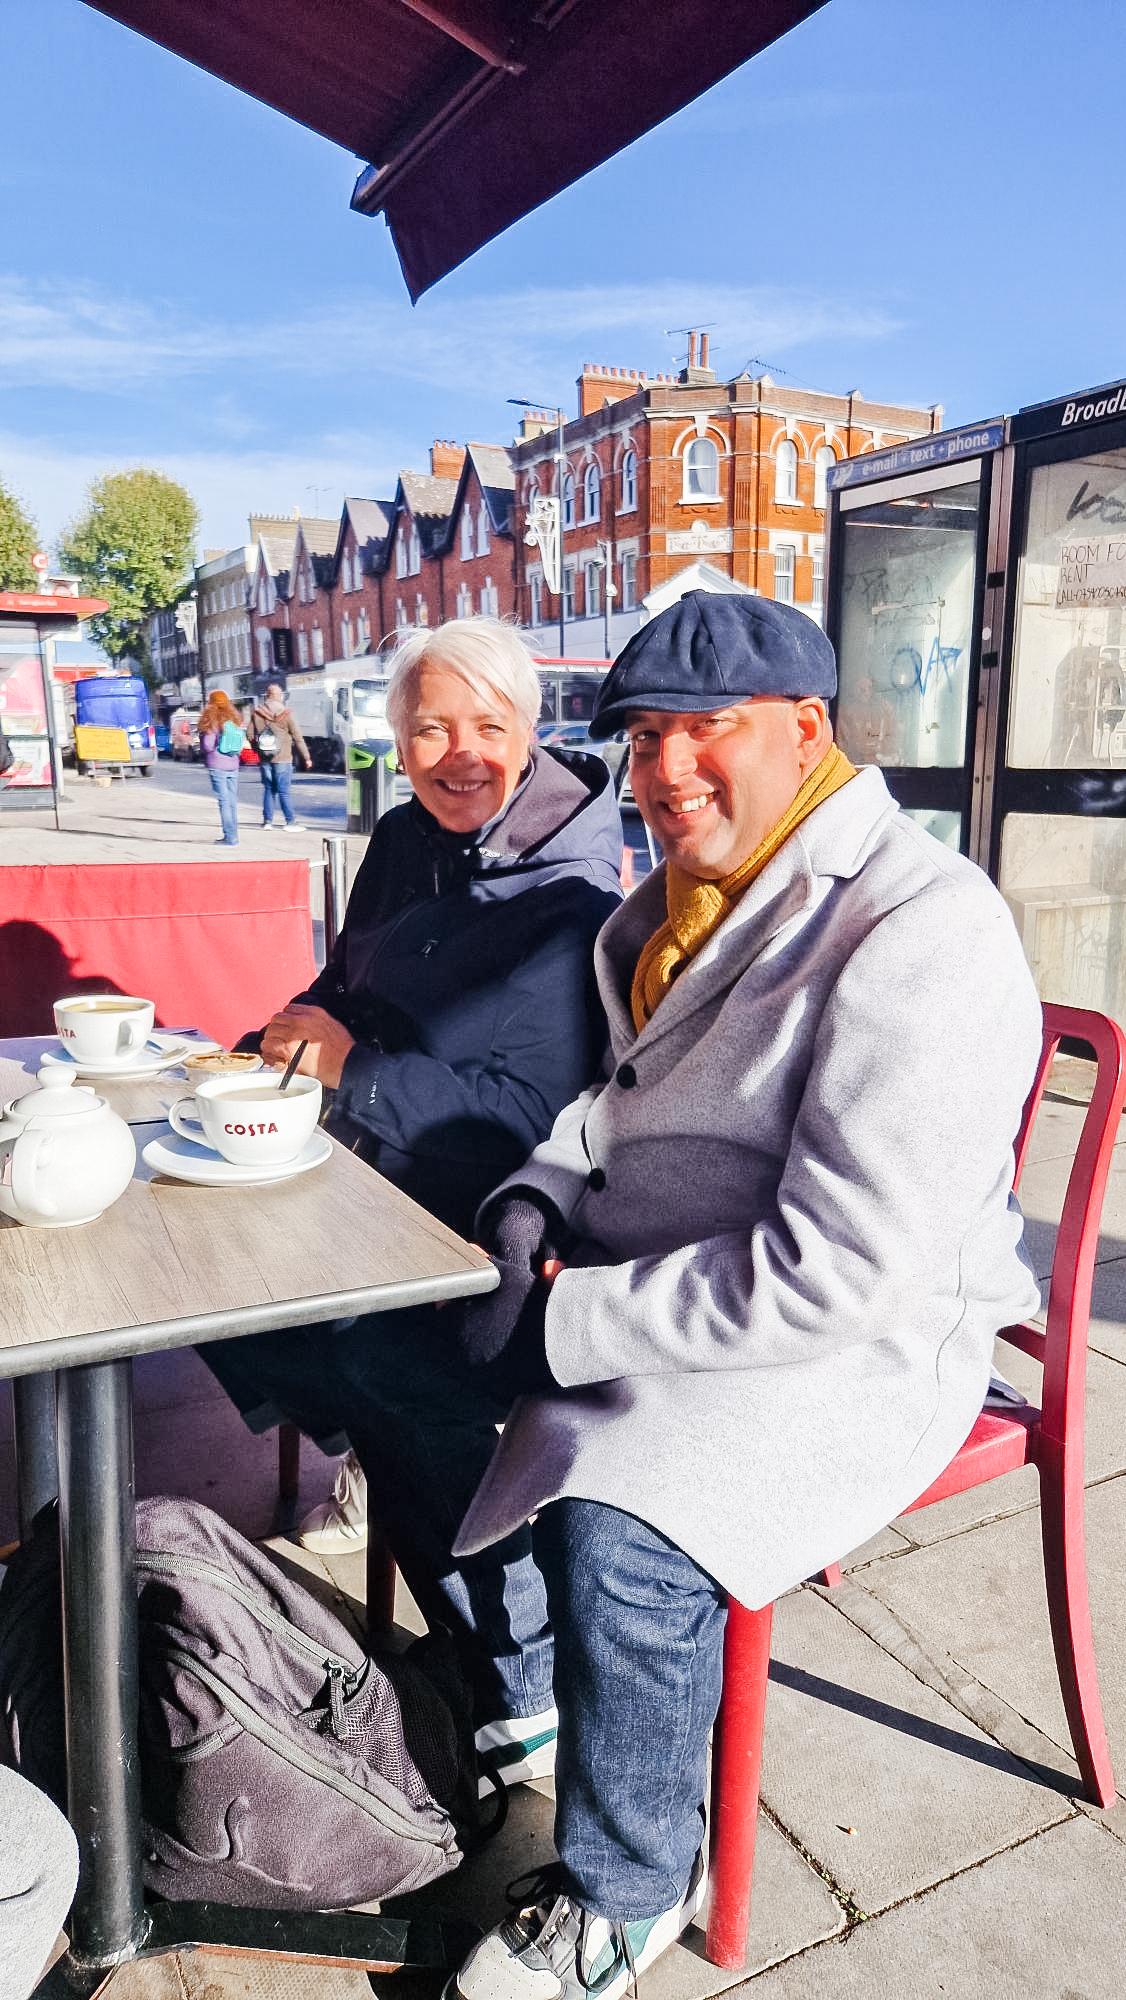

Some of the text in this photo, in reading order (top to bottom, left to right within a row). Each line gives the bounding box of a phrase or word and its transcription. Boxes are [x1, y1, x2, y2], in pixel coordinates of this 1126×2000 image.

[862, 431, 990, 476] e-mail text phone
[1061, 544, 1100, 565] ROOM
[1060, 563, 1095, 585] RENT
[224, 1122, 279, 1137] COSTA
